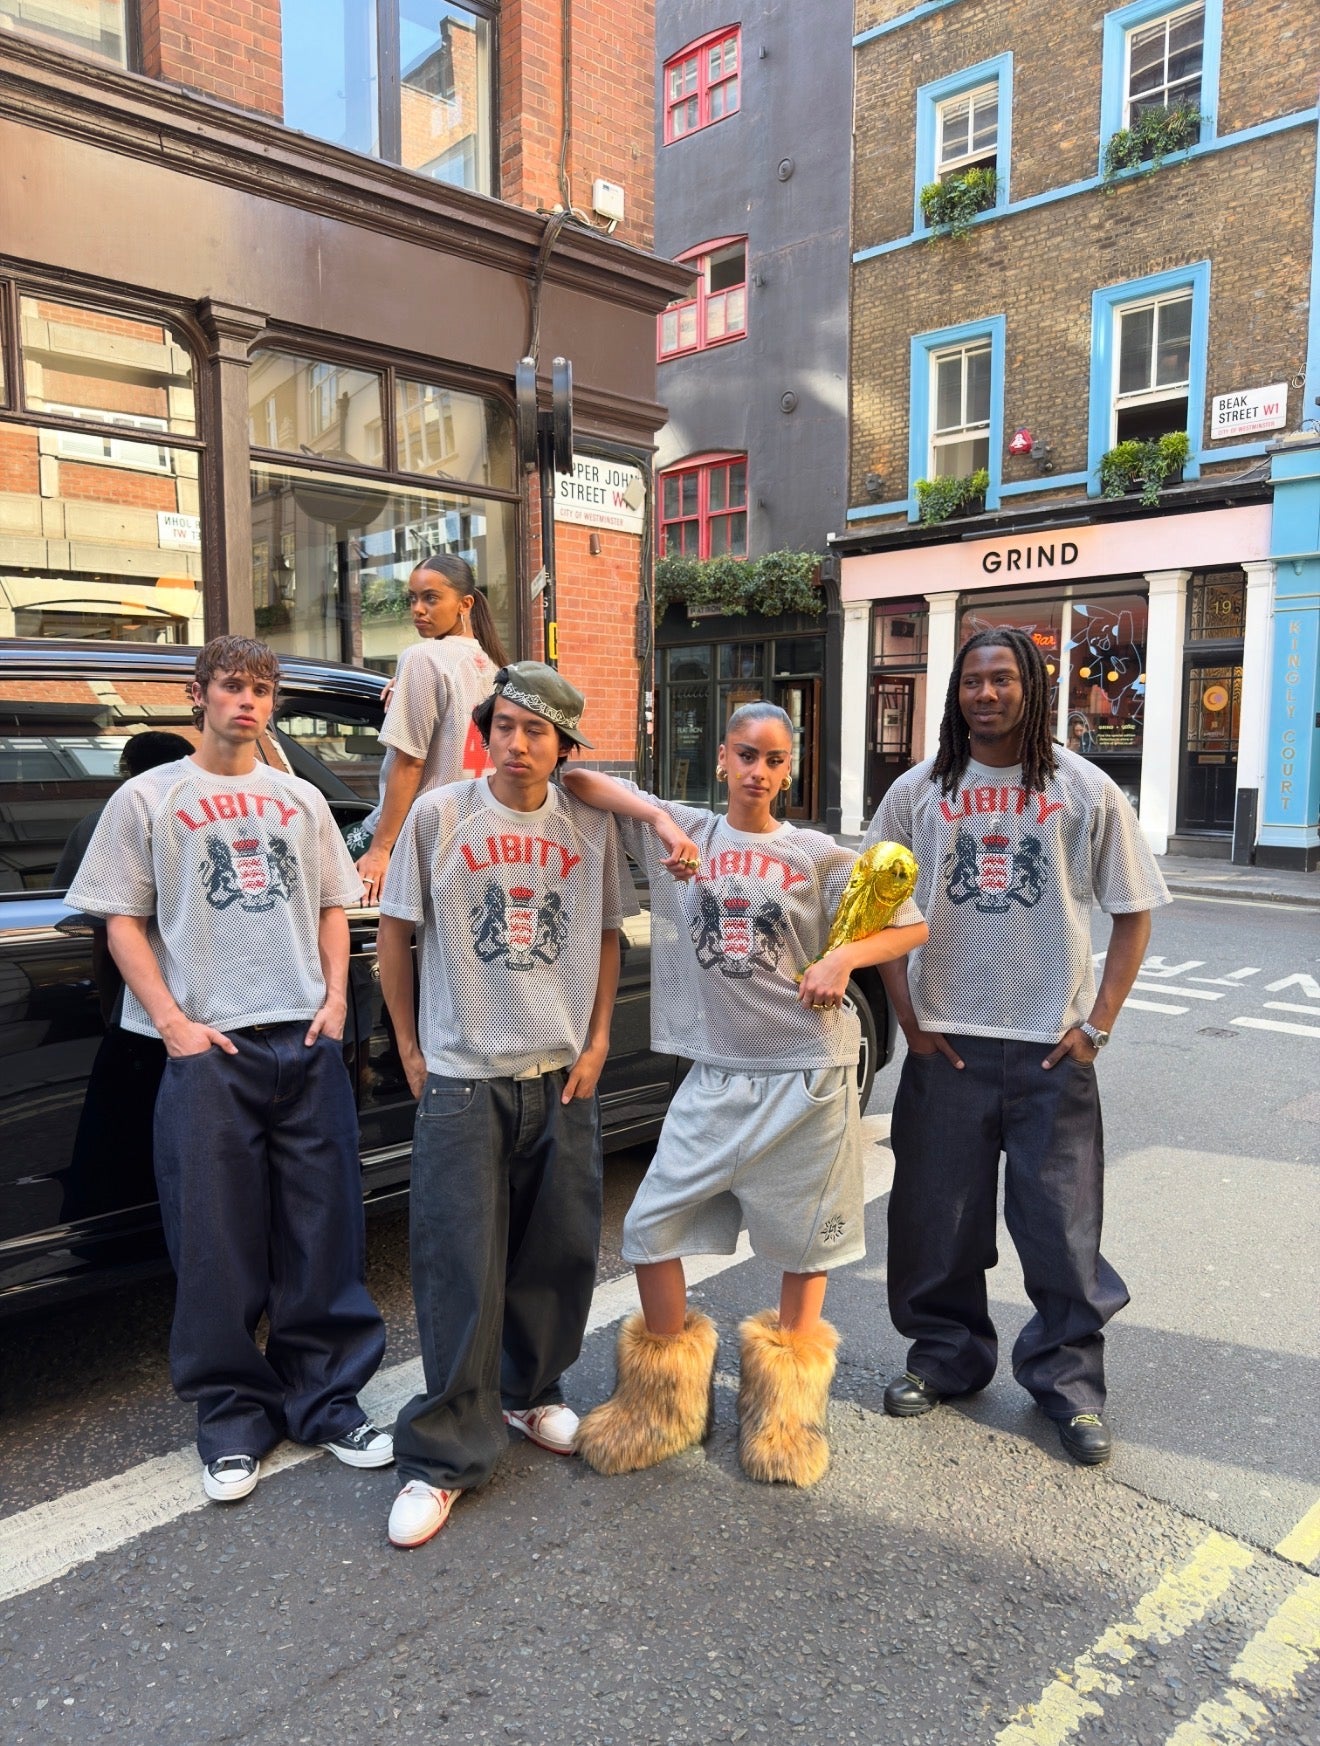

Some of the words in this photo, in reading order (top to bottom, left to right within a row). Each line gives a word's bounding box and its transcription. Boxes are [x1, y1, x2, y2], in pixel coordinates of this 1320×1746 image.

[1218, 406, 1259, 424] STREET
[1263, 402, 1280, 416] W1
[1219, 395, 1248, 411] BEAK
[1238, 421, 1275, 432] WESTMINSTER
[572, 462, 599, 482] PER
[604, 469, 640, 489] JOH
[560, 480, 607, 505] STREET
[612, 490, 630, 510] W
[560, 508, 575, 517] CITY
[575, 510, 583, 519] OF
[584, 512, 624, 526] WESTMINSTER
[982, 542, 1079, 574] GRIND
[1211, 600, 1232, 615] 19
[1285, 621, 1300, 719] KINGLY
[1280, 730, 1296, 811] COURT
[175, 792, 299, 832] LIBITY
[939, 785, 1066, 825] LIBITY
[460, 834, 581, 879] LIBITY
